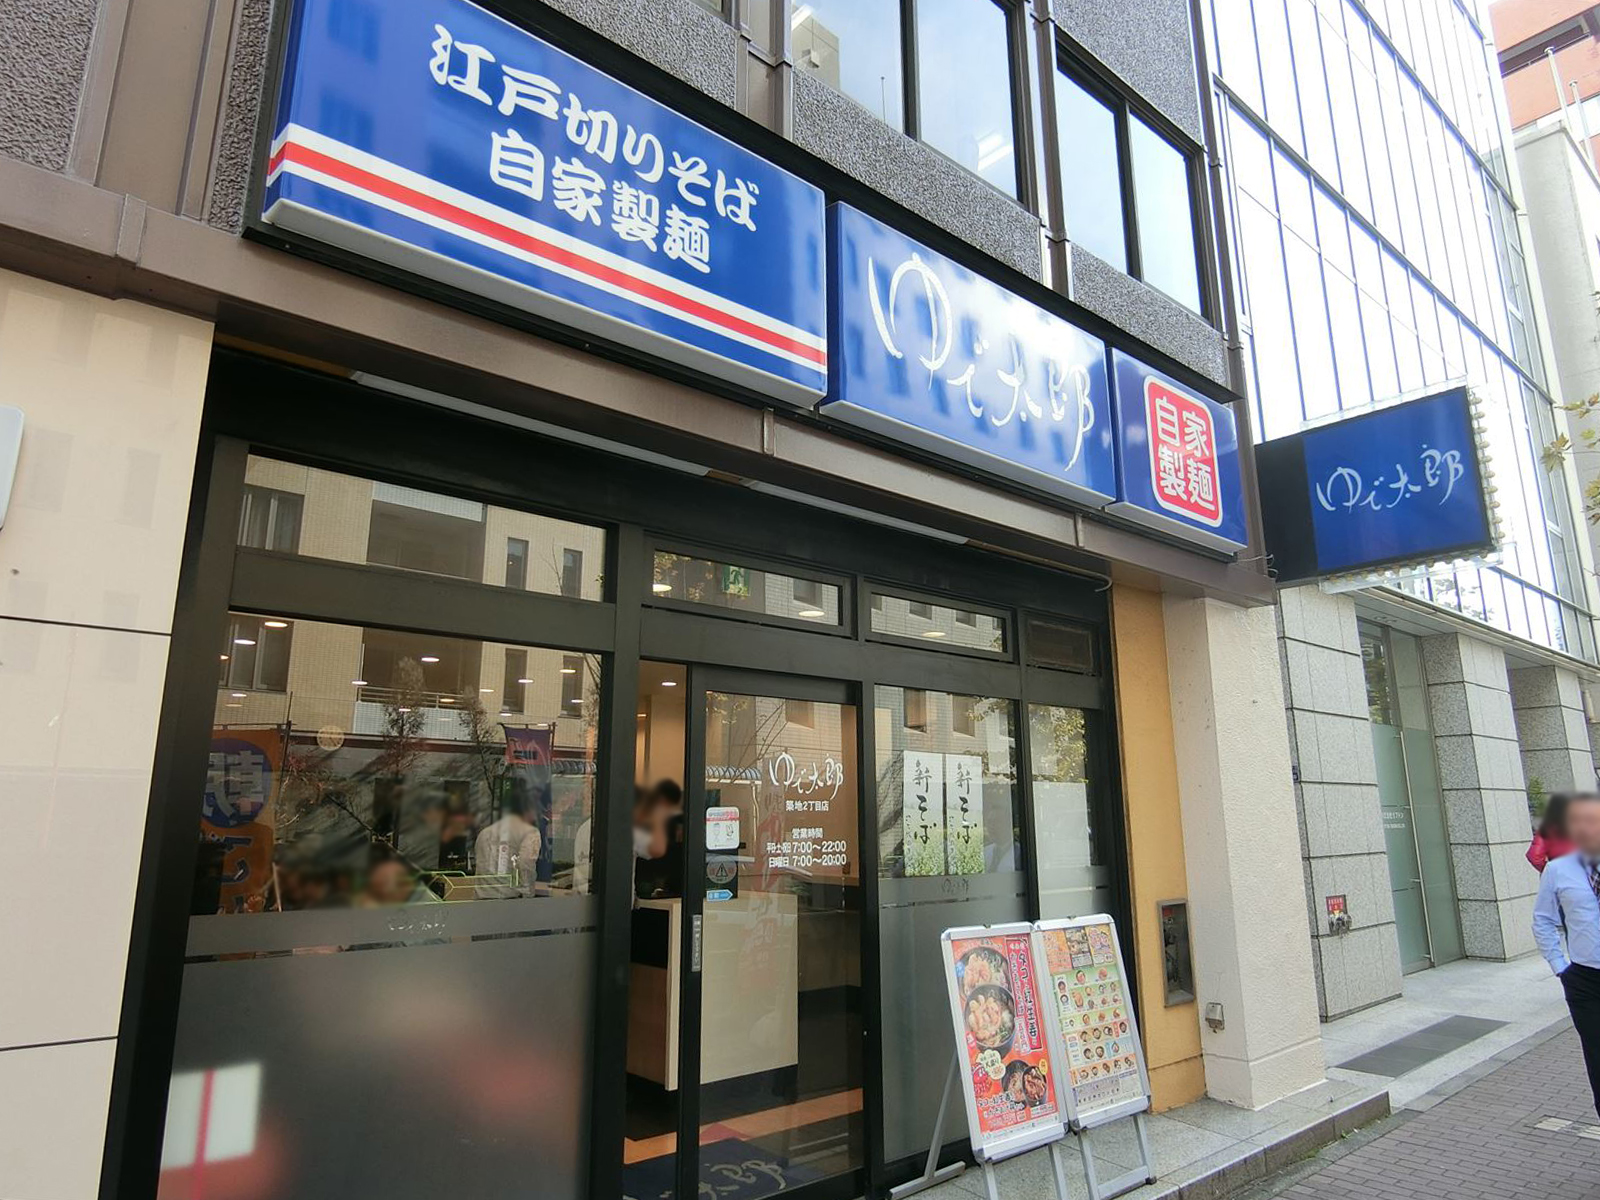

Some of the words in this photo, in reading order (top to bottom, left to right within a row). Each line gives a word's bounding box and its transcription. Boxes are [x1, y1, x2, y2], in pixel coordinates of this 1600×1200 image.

[429, 24, 760, 232] 江戸切りそば
[489, 129, 711, 274] 自家製麺
[868, 252, 1095, 472] ゆで太郎
[1154, 396, 1209, 458] 自家
[1158, 446, 1215, 512] 製麺
[1315, 443, 1465, 514] ゆで太郎
[768, 751, 844, 800] ゆで太郎
[785, 800, 830, 812] 築地2丁目店
[768, 856, 790, 868] 日曜日
[791, 827, 824, 839] 営業時間
